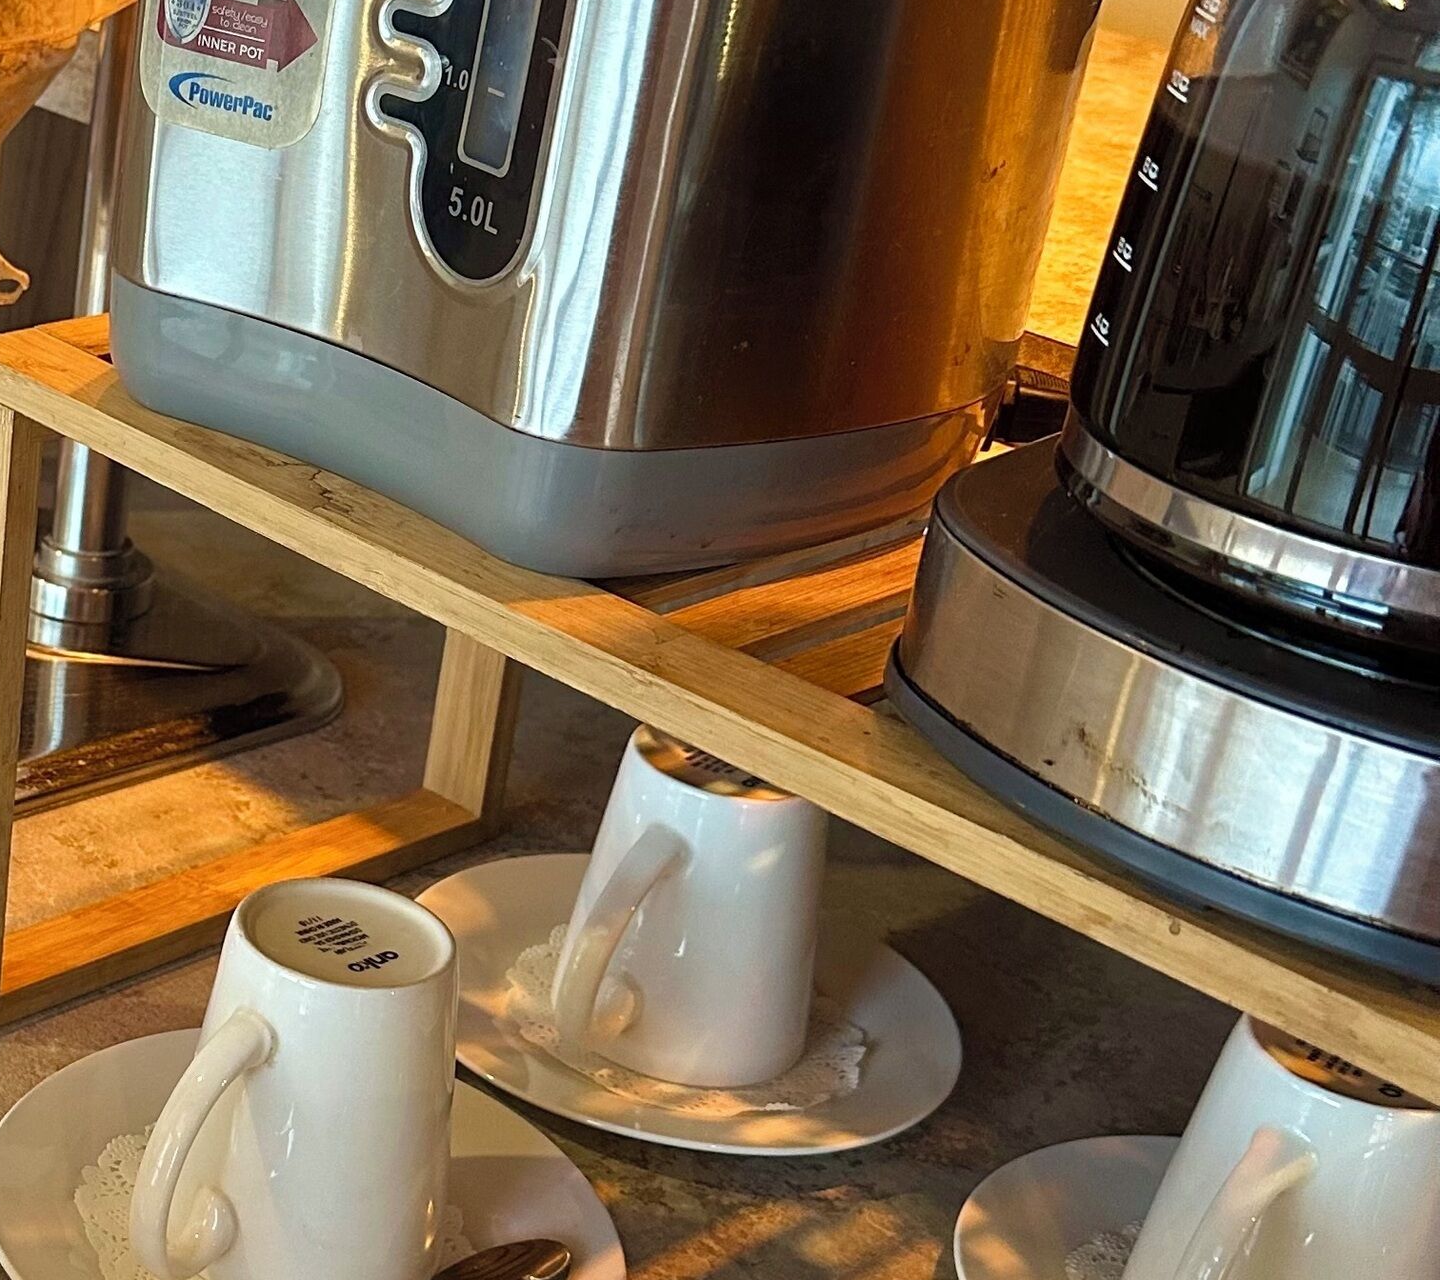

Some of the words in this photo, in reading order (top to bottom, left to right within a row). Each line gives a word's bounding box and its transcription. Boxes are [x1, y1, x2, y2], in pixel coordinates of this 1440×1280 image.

[197, 34, 236, 54] INNER
[239, 45, 264, 60] POT
[445, 64, 469, 91] 1.0
[448, 186, 498, 236] 5.0L
[347, 950, 399, 972] anko
